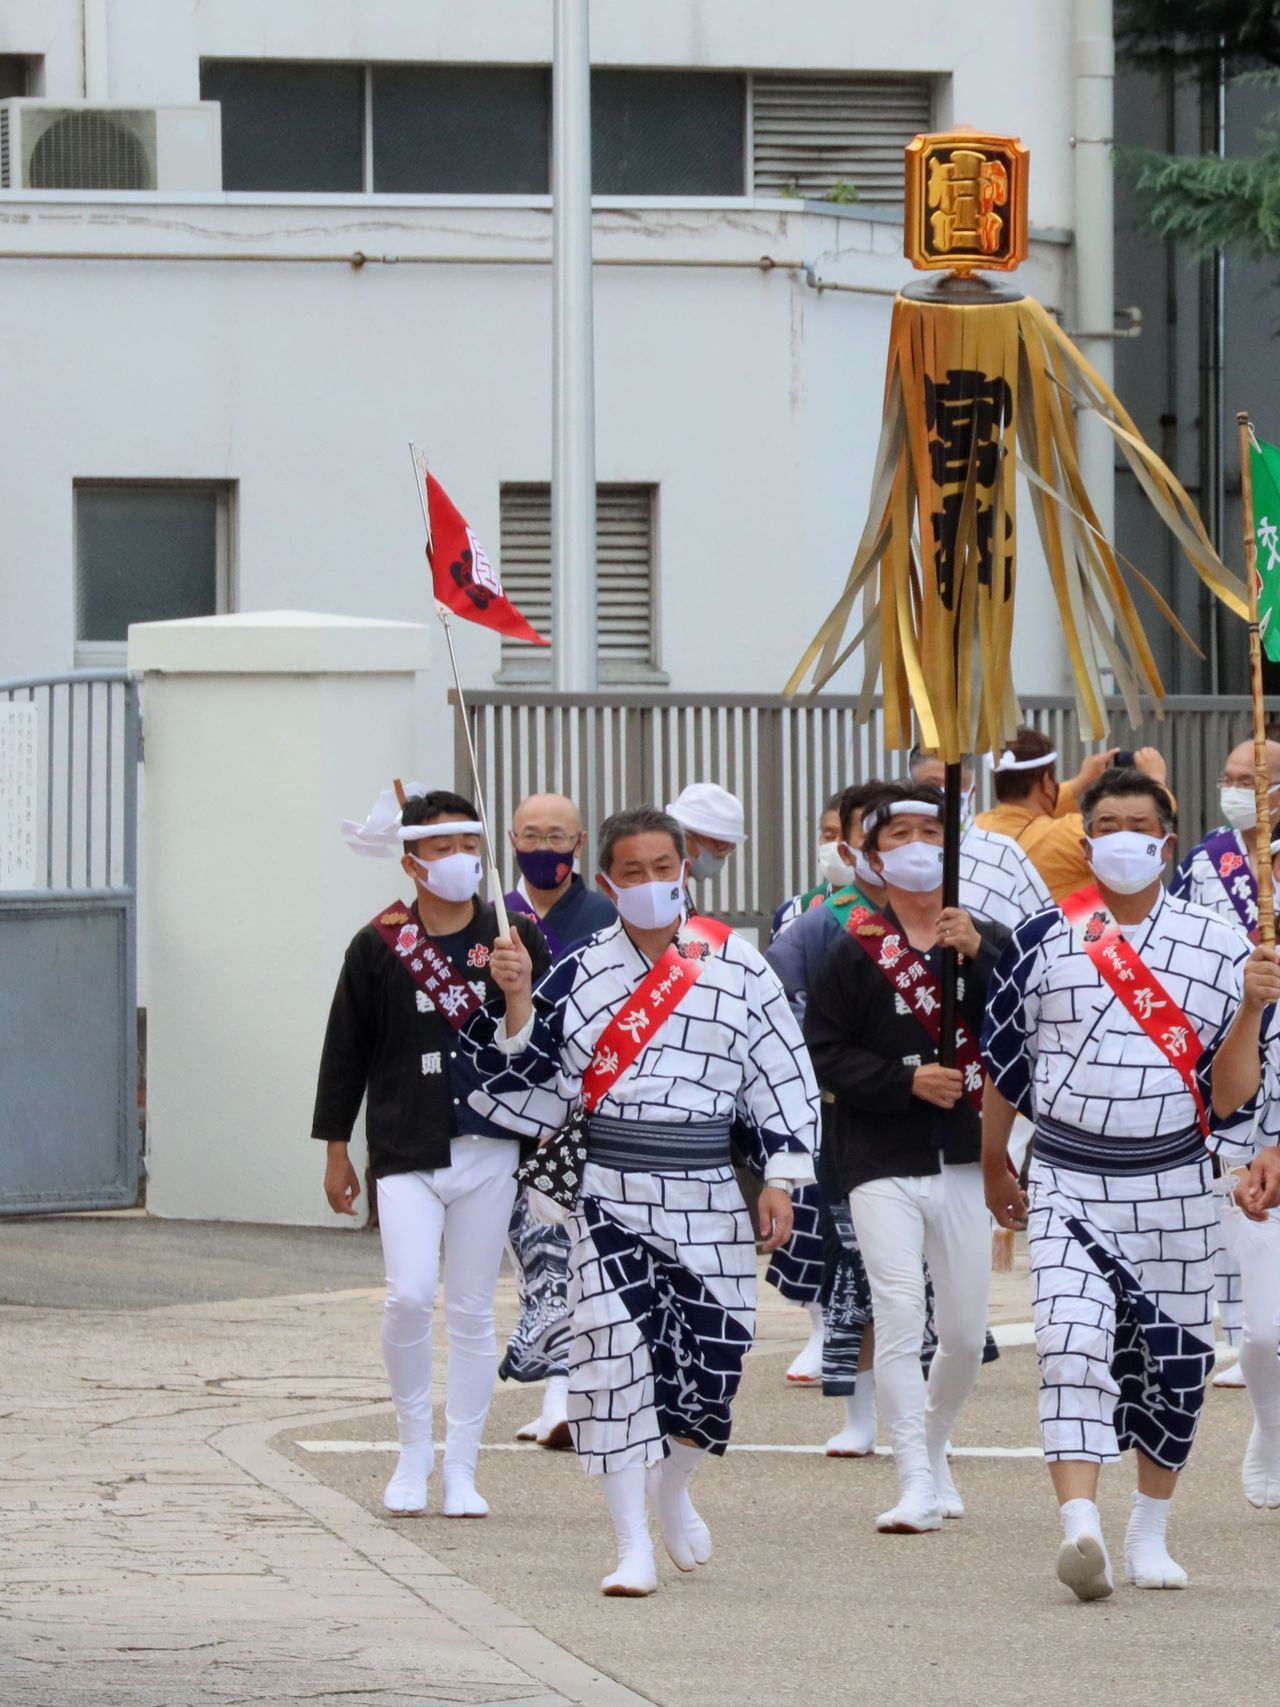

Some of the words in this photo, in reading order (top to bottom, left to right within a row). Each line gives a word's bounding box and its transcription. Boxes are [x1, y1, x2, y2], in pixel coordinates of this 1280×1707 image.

[1102, 944, 1135, 982] 宮本町
[649, 964, 685, 1007] 宮本町
